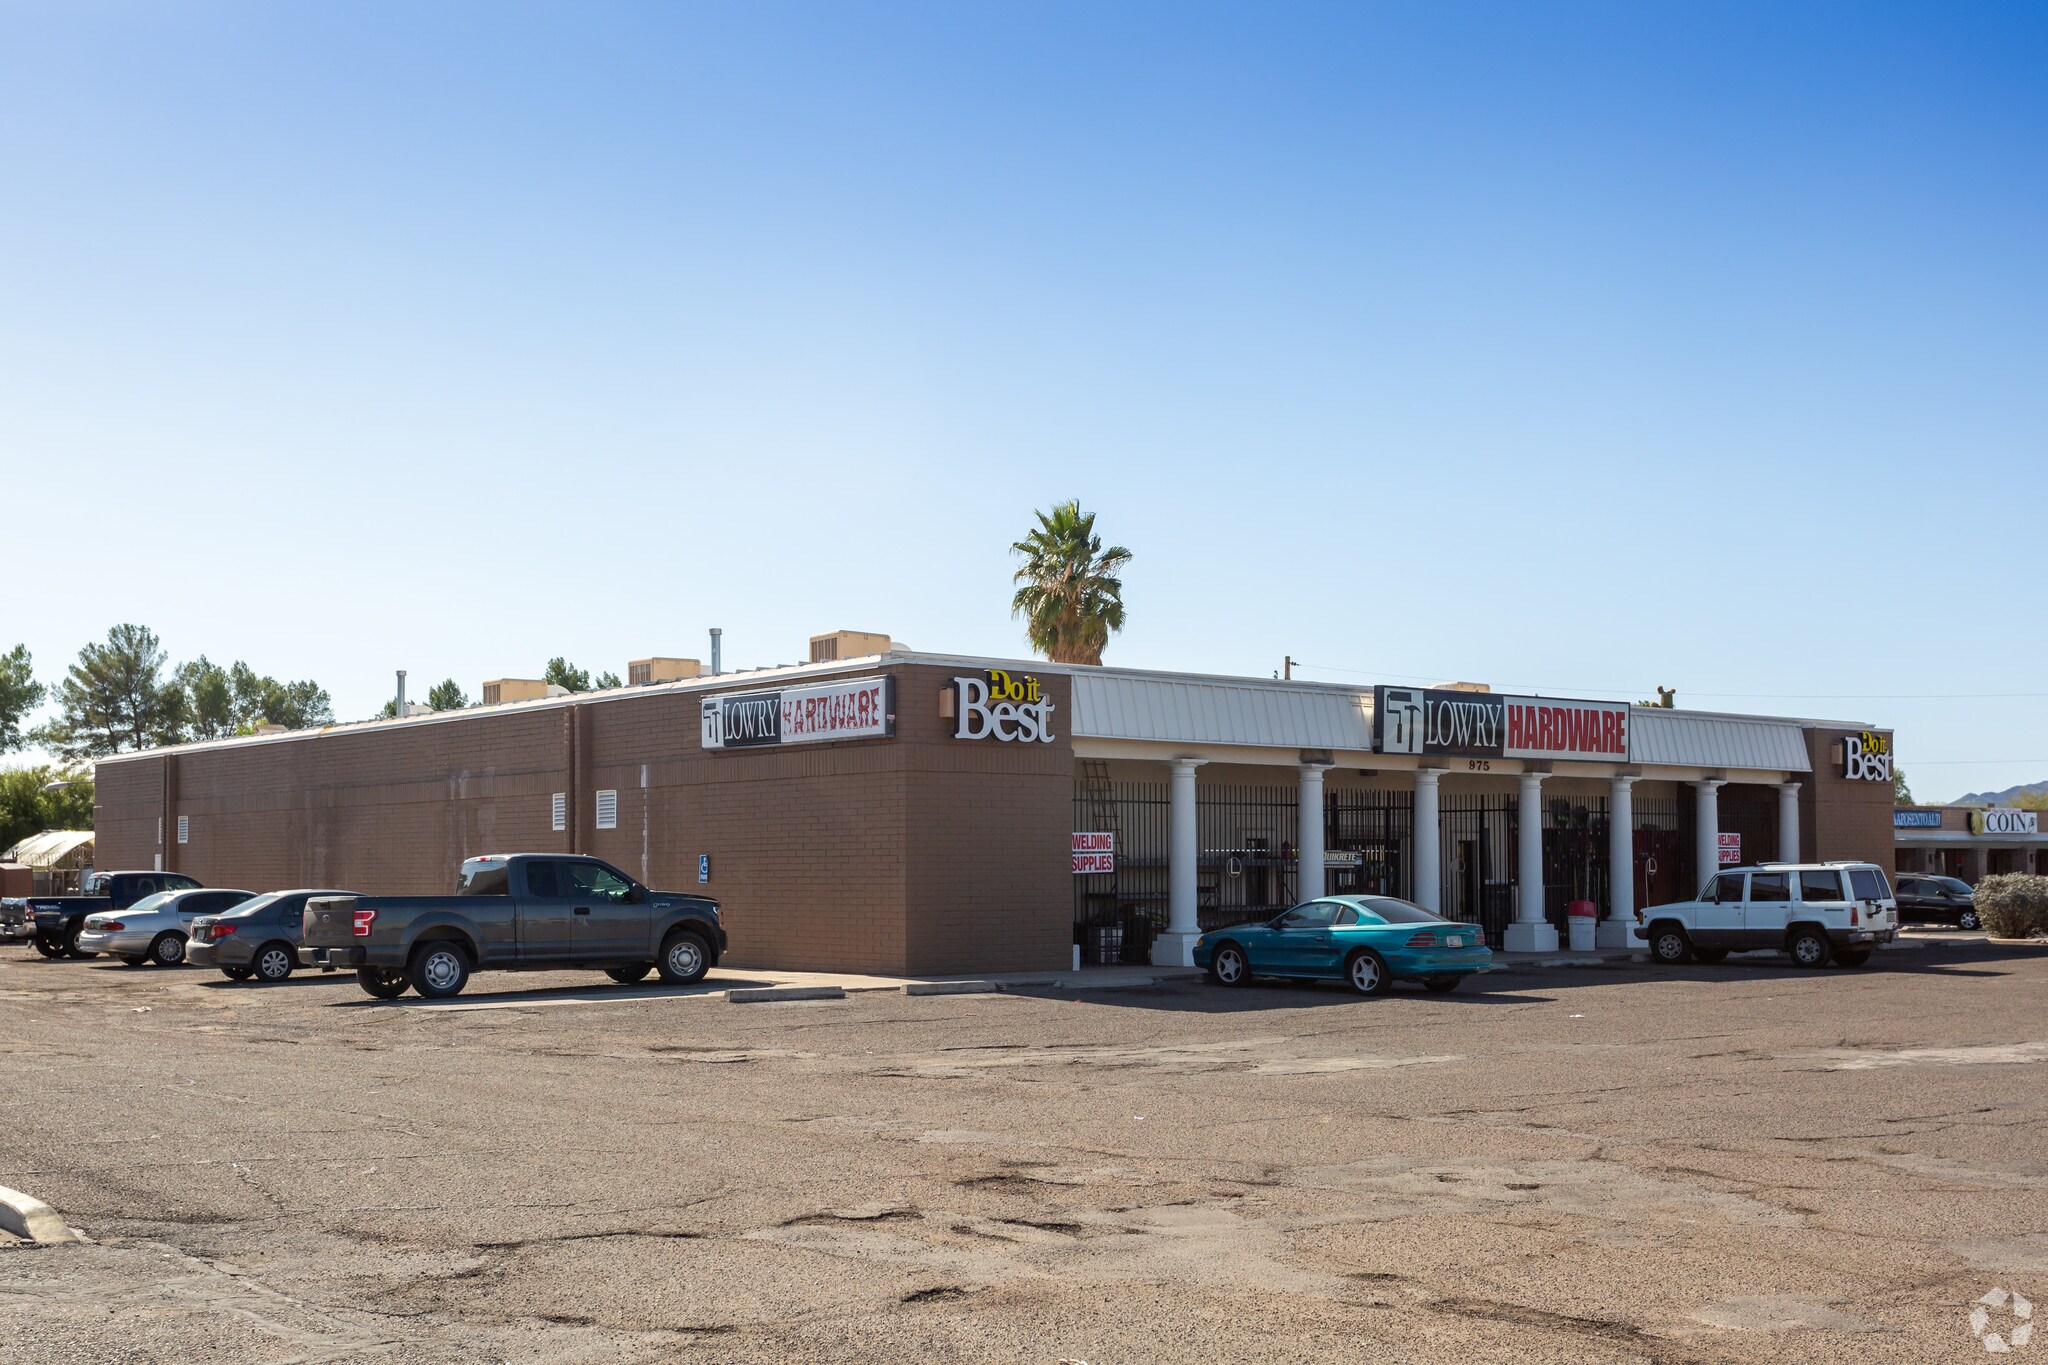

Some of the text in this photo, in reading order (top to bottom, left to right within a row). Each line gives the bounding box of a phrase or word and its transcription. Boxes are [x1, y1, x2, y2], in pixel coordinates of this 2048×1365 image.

[988, 669, 1041, 702] Do it
[724, 686, 880, 740] LOWRY HARDWARE
[954, 676, 1055, 744] Best
[1426, 700, 1626, 754] LOWRY HARDWARE
[1862, 731, 1878, 753] Do
[1468, 759, 1490, 772] 975
[1845, 736, 1893, 782] Best
[1986, 813, 2026, 832] COIN
[1071, 834, 1112, 850] WELDING
[1072, 855, 1113, 871] SUPPLIES
